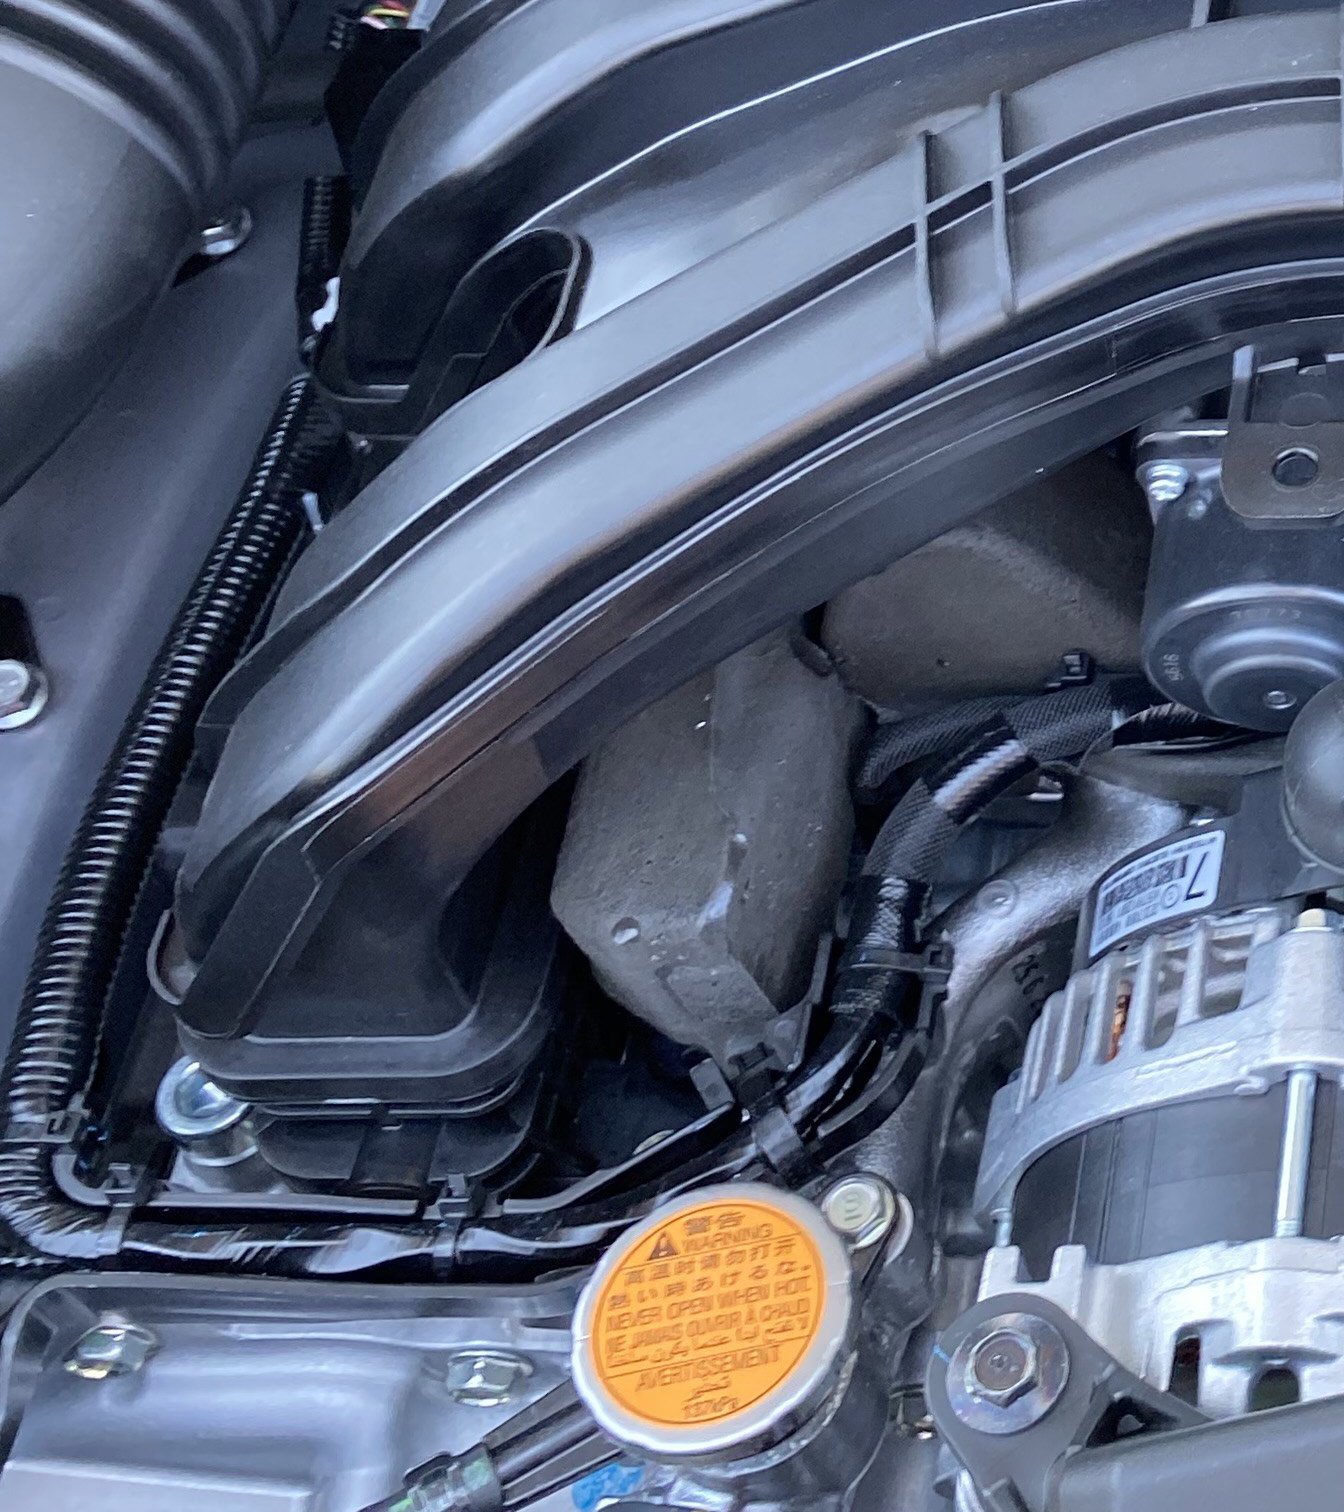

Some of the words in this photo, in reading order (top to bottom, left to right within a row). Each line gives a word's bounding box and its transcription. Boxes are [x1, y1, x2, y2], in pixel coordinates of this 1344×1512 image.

[683, 1223, 773, 1252] WARNING
[607, 1306, 662, 1331] NEVER
[667, 1295, 713, 1319] OPEN
[717, 1284, 770, 1309] WHEN
[630, 1322, 683, 1349] JAMAIS
[635, 1343, 780, 1391] AVERTISSEMENT
